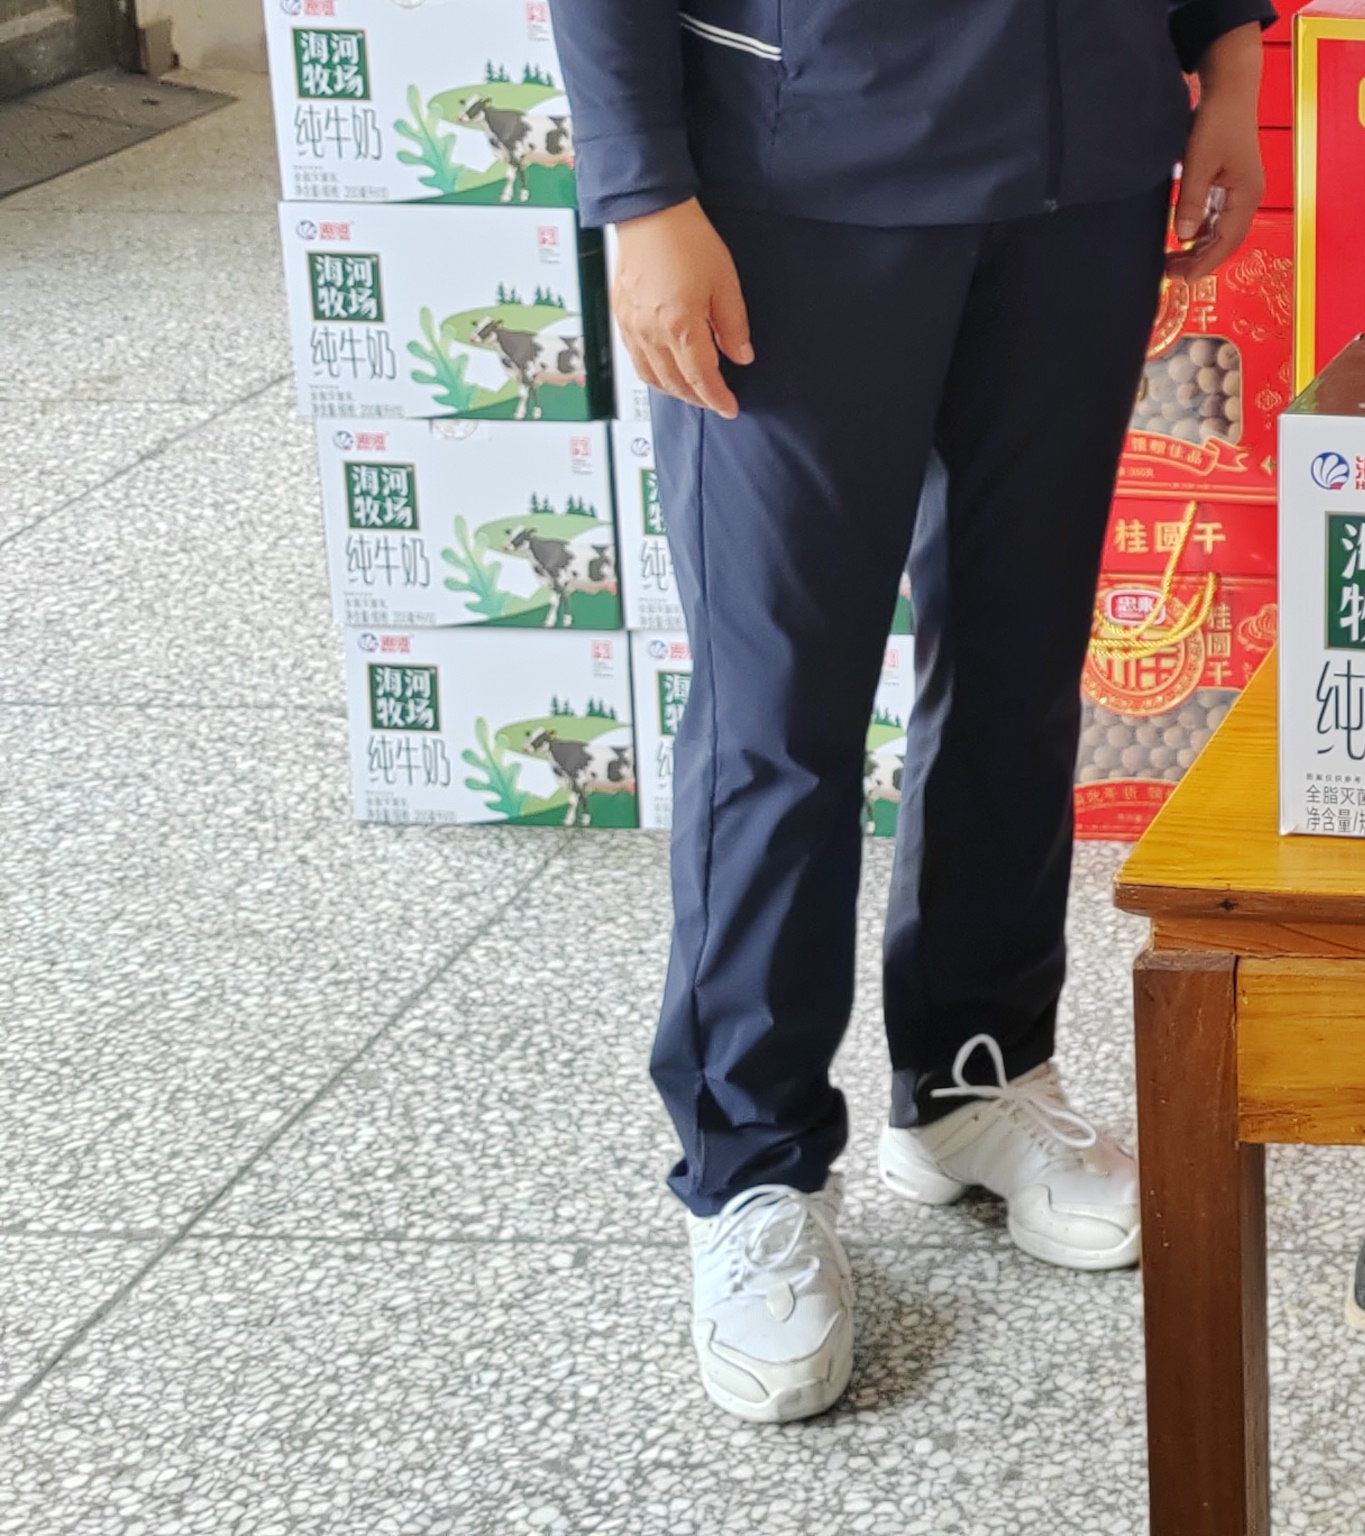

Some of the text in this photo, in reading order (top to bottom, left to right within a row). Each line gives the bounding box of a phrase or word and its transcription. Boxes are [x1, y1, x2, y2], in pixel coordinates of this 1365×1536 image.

[300, 31, 360, 64] 海河
[303, 65, 365, 98] 牧场
[294, 105, 383, 161] 纯牛奶
[316, 255, 374, 287] 海河
[318, 287, 379, 320] 牧场
[310, 326, 397, 381] 纯牛奶
[352, 465, 410, 496] 海河
[353, 496, 413, 529] 牧场
[1114, 518, 1227, 554] 桂圆干
[345, 534, 430, 588] 纯牛奶
[375, 666, 431, 697] 海河
[377, 698, 435, 730] 牧场
[368, 735, 451, 788] 纯牛奶
